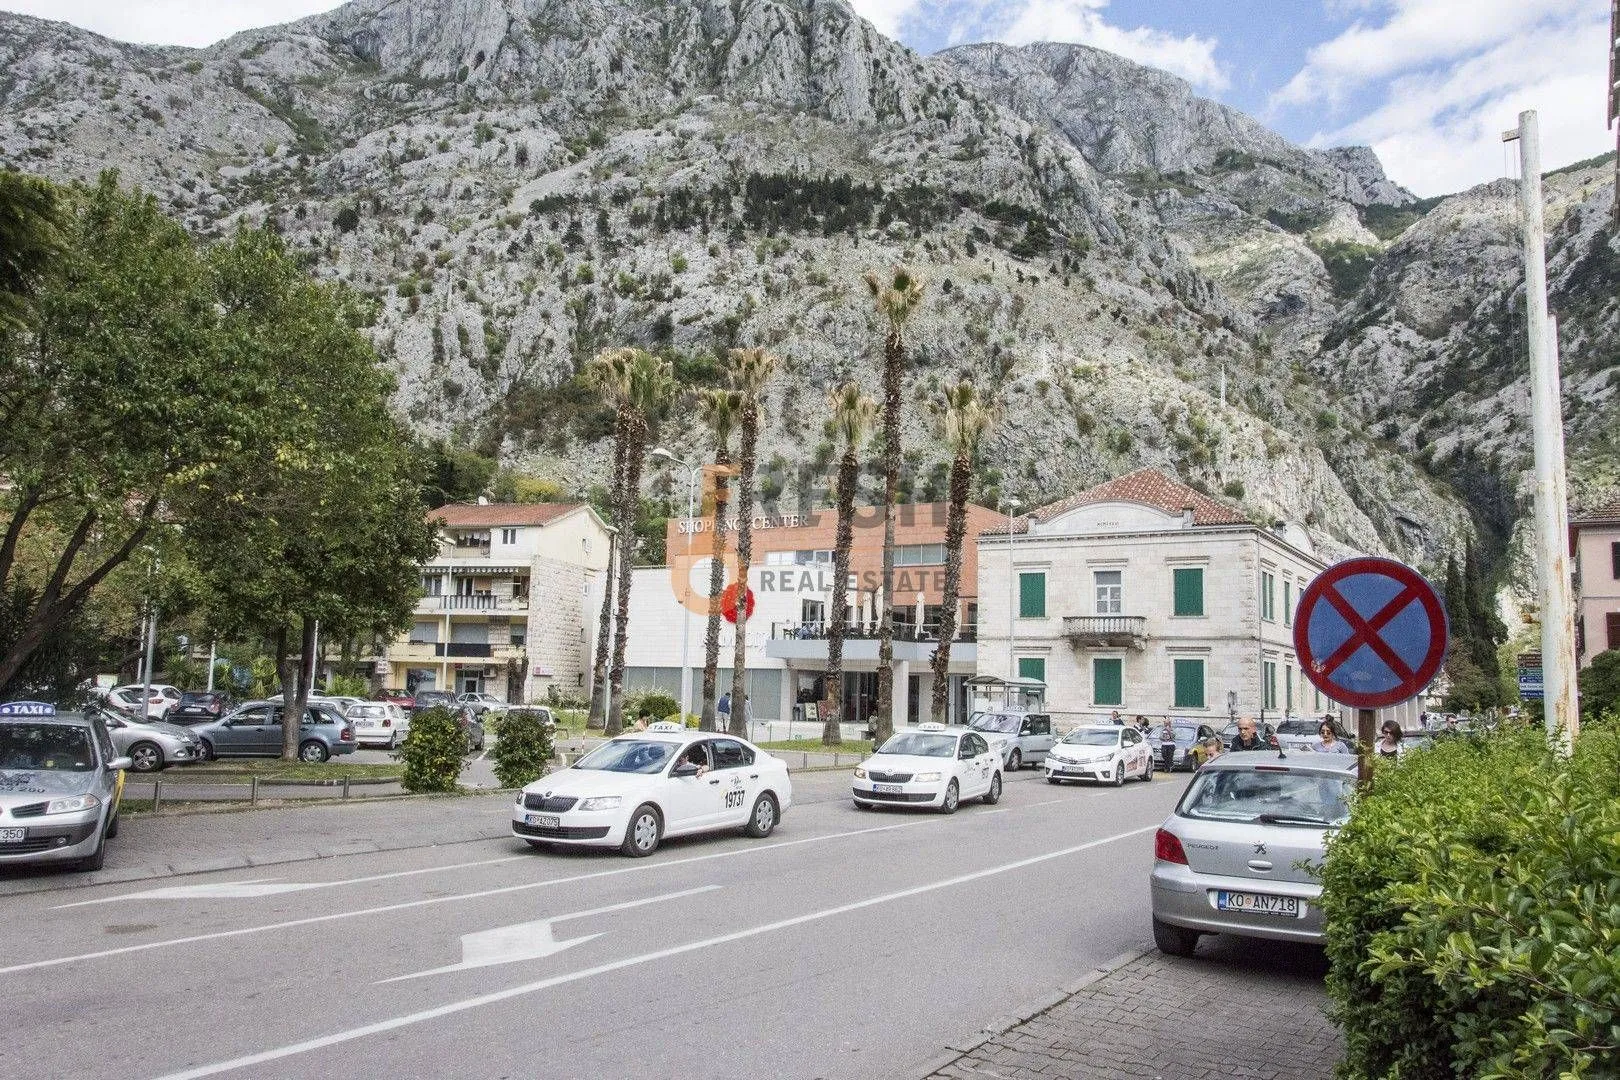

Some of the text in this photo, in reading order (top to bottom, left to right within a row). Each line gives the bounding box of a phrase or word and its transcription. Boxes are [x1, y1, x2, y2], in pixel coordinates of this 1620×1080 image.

[752, 514, 809, 530] CENTER
[12, 705, 43, 714] TAXI
[725, 790, 745, 808] 19737
[1228, 893, 1295, 911] KO AN718
